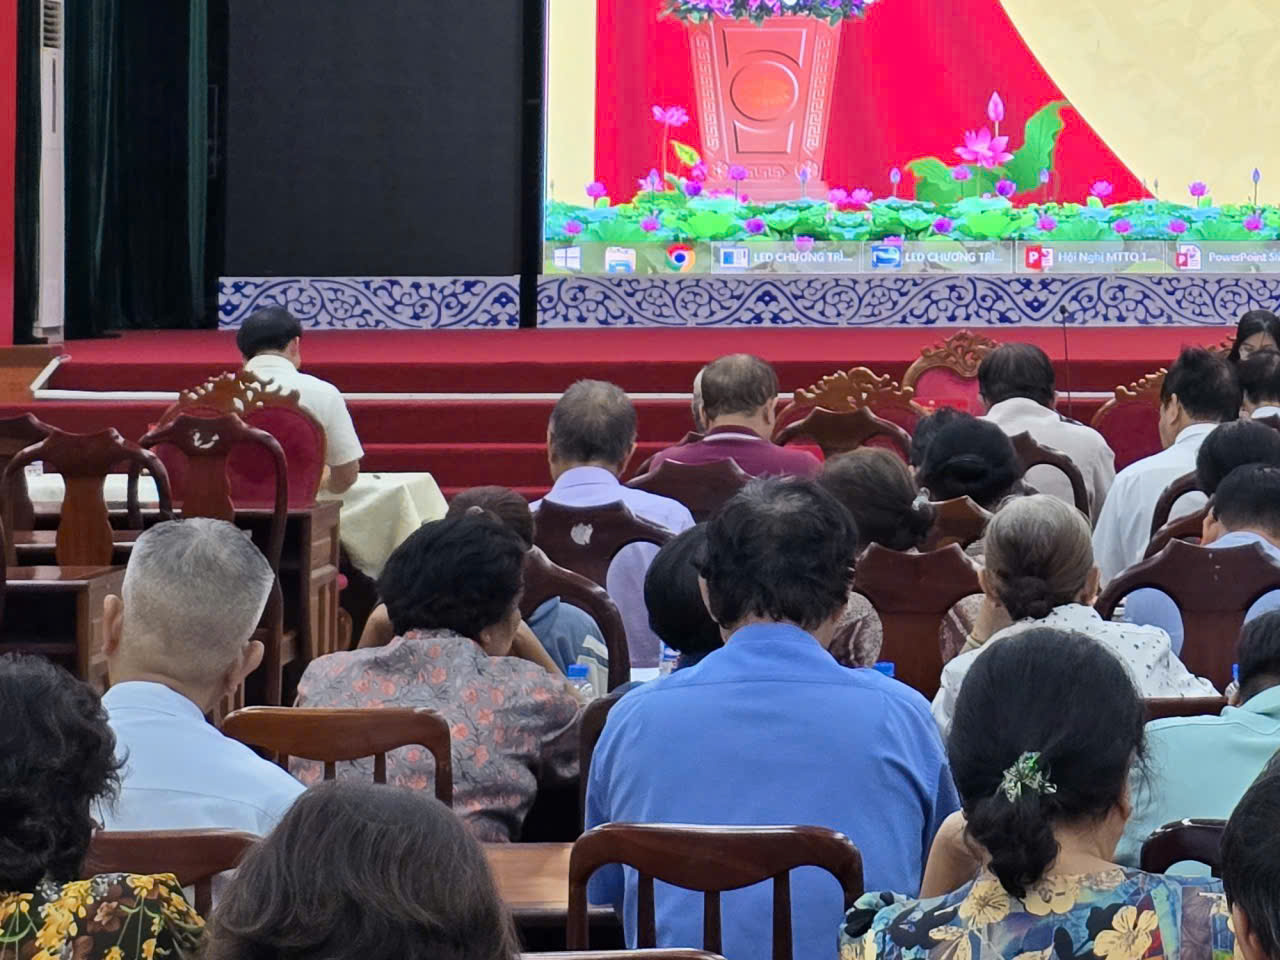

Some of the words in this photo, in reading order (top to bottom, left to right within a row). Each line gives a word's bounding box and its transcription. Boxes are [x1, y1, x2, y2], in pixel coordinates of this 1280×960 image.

[753, 251, 774, 263] LED
[905, 251, 925, 263] LED
[1208, 250, 1267, 263] PowerPoint
